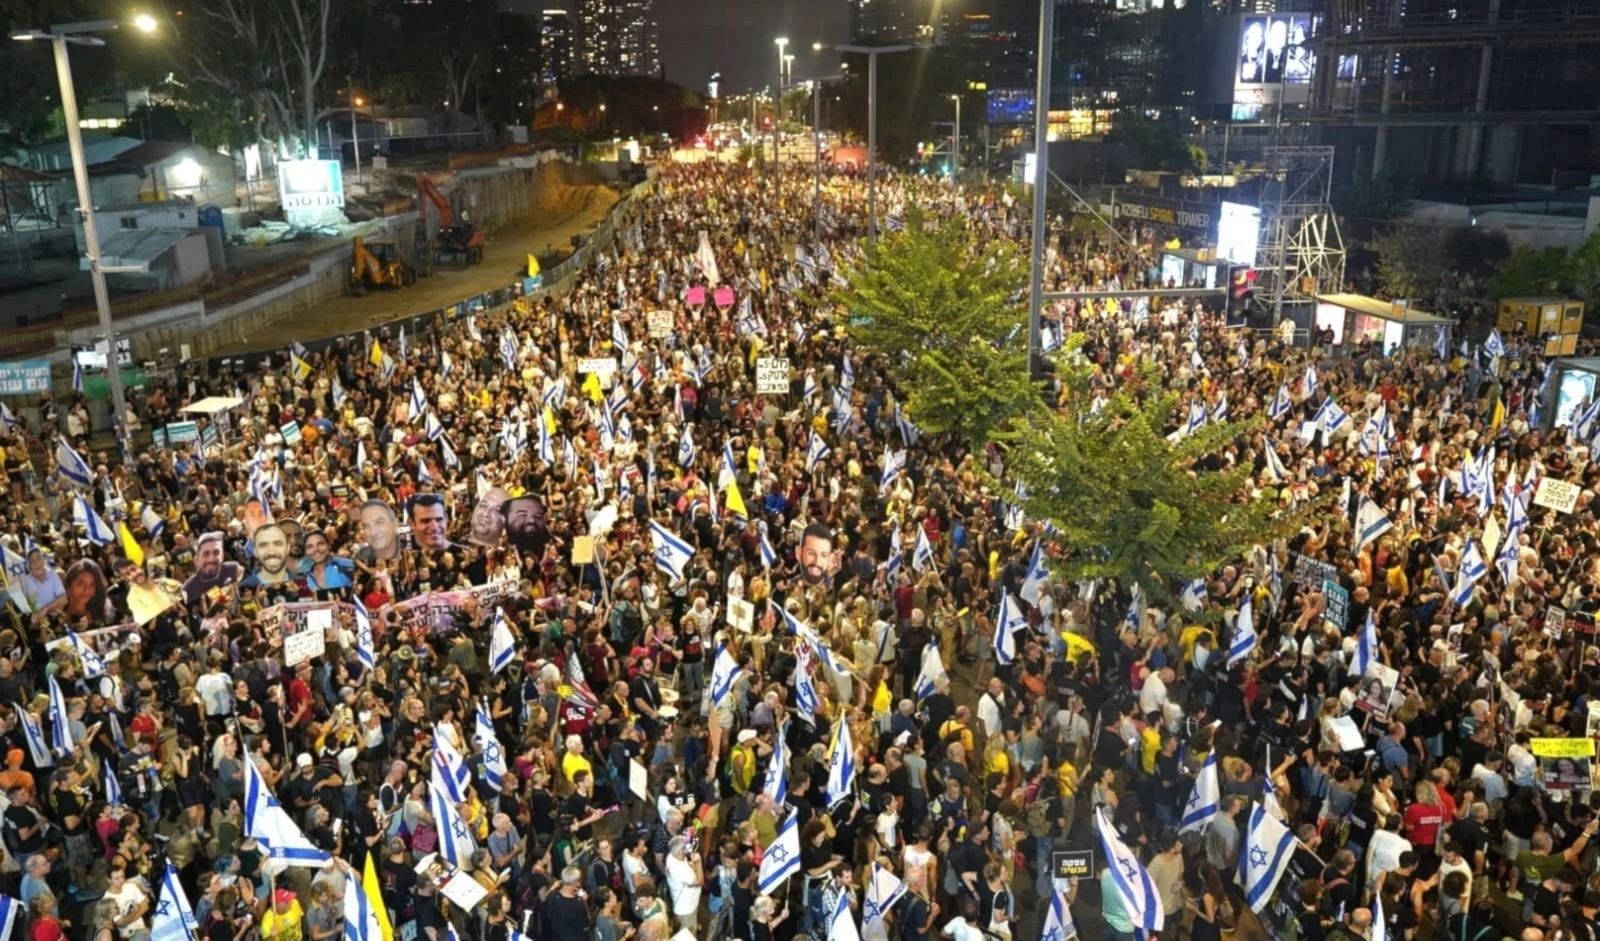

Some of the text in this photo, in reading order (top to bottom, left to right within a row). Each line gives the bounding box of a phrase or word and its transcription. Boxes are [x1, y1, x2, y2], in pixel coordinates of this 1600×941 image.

[1149, 206, 1175, 224] SPIRAL
[1176, 211, 1209, 228] TOWER
[1328, 588, 1344, 605] SEAL
[1329, 599, 1342, 614] THE
[1326, 607, 1344, 625] DEAL
